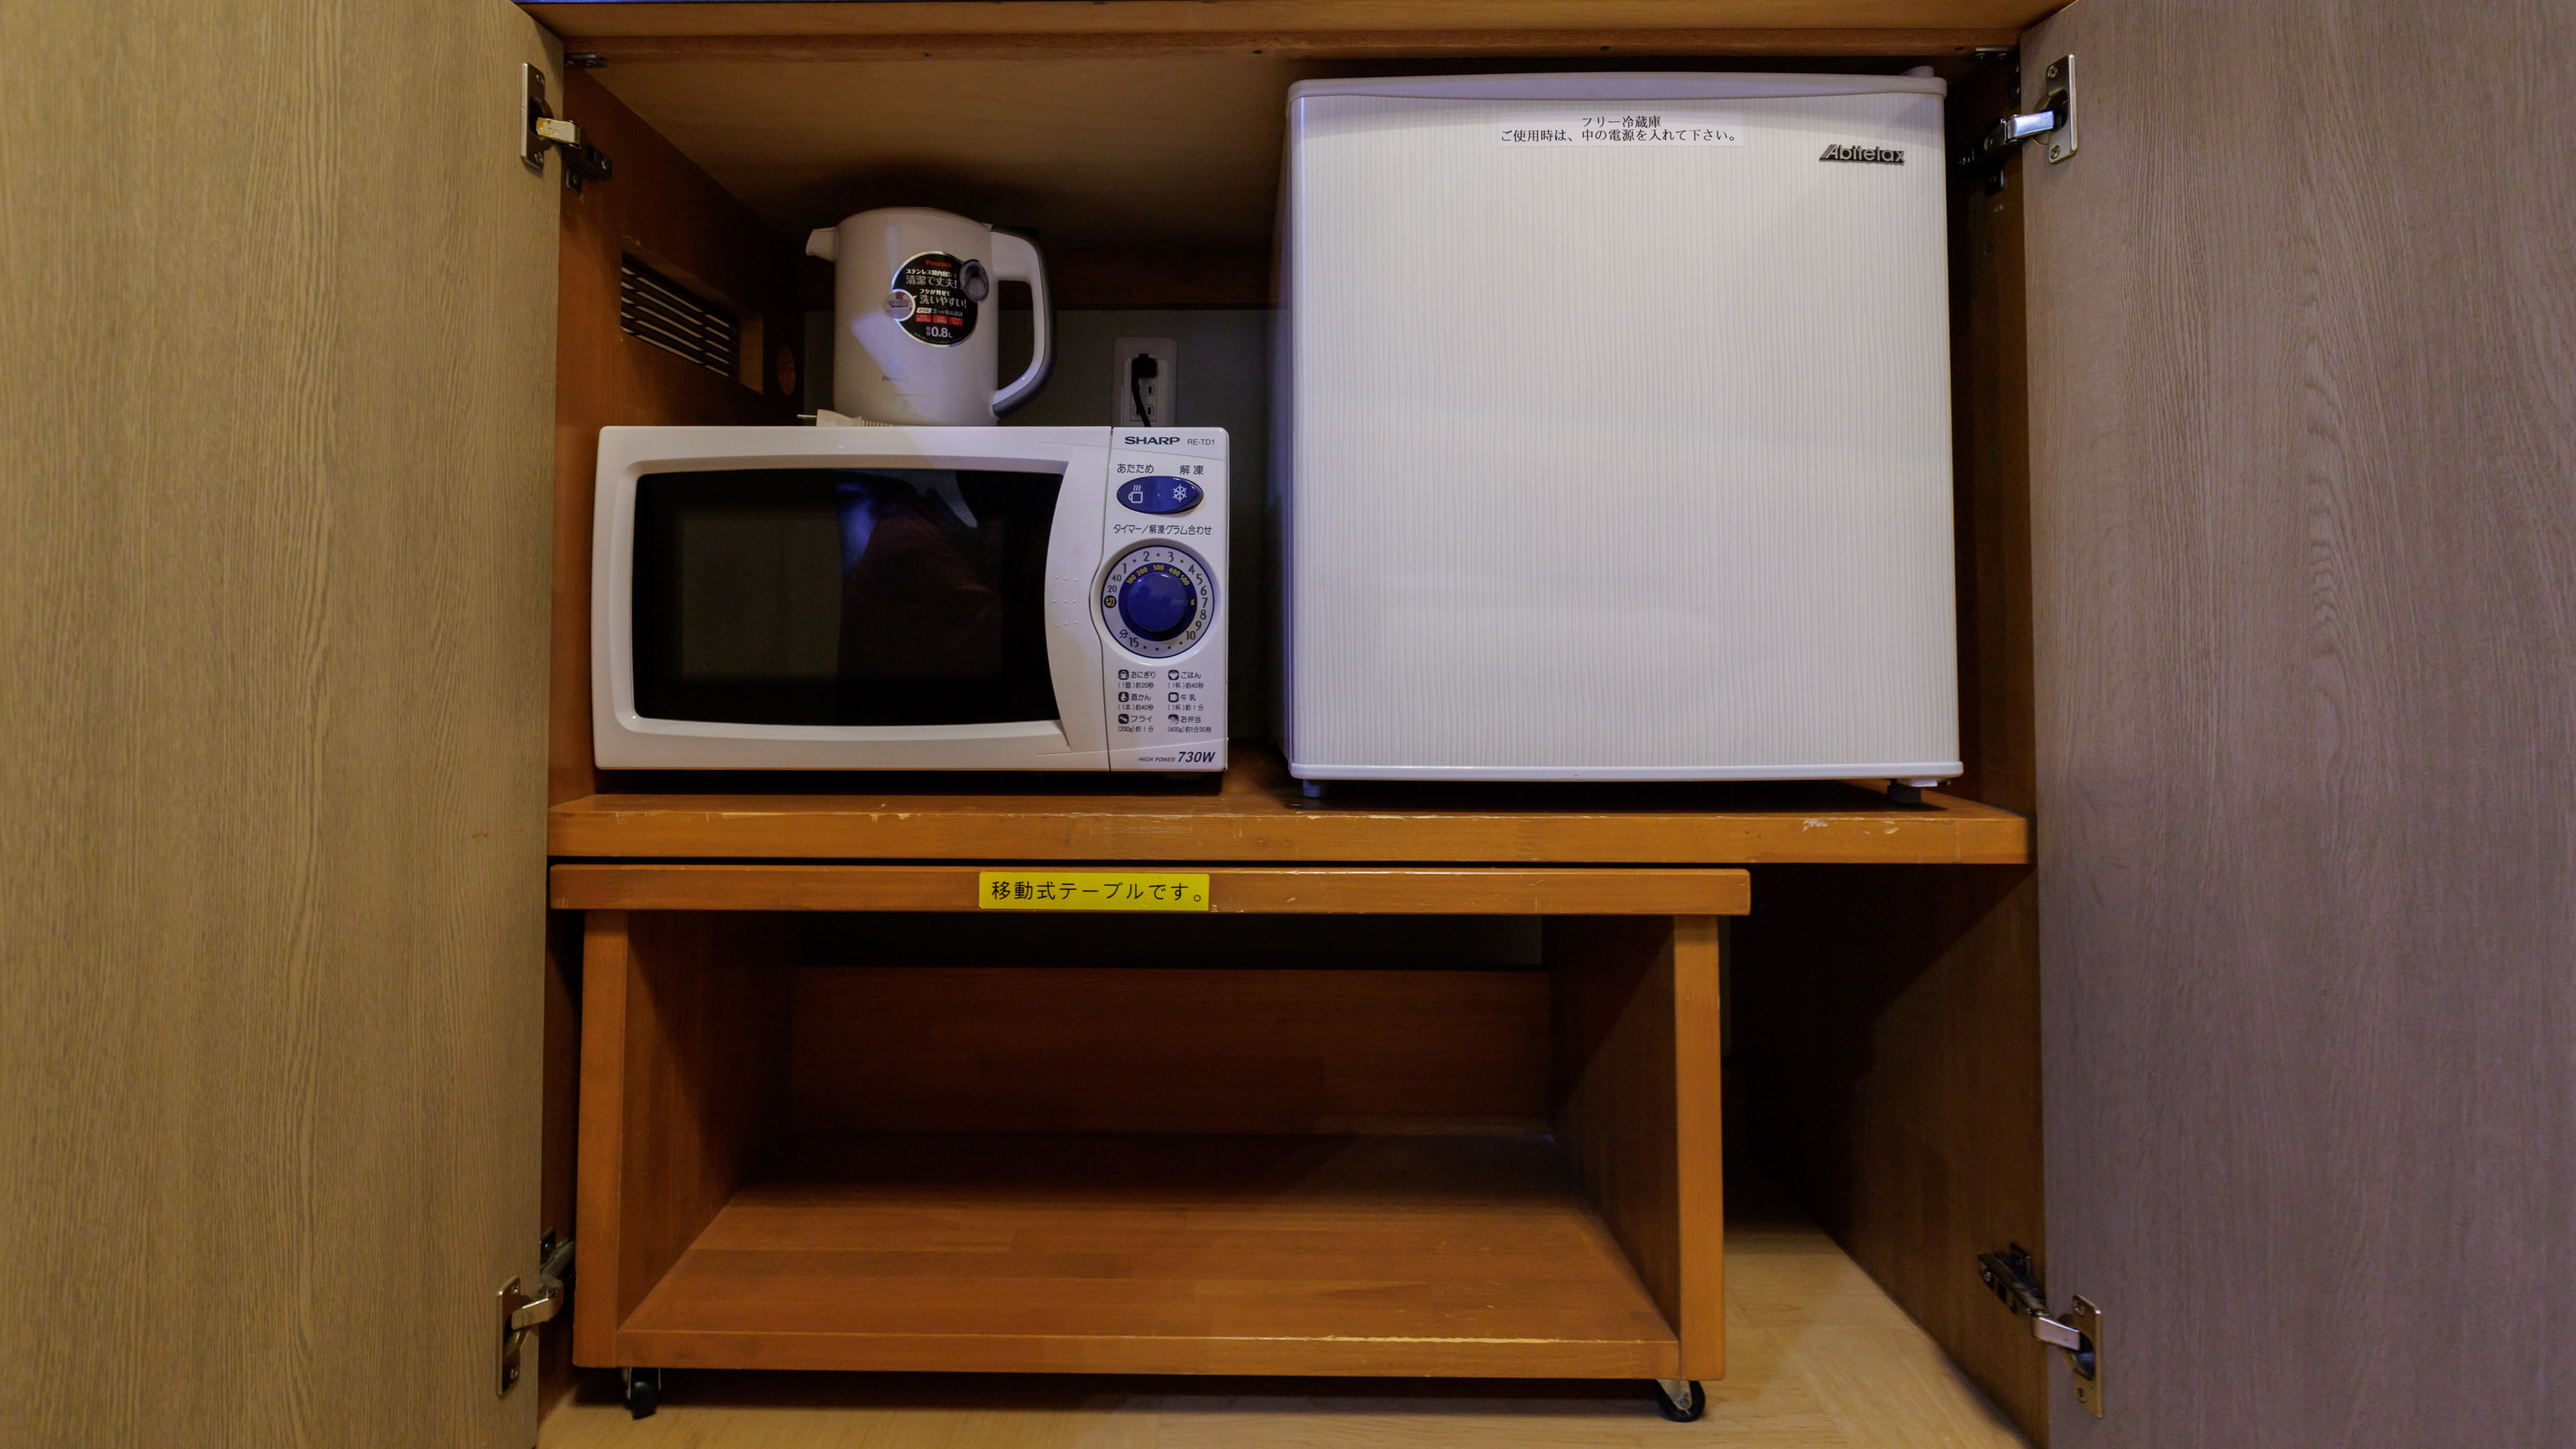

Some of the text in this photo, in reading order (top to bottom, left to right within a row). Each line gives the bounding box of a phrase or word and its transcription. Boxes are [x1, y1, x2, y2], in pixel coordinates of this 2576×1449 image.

[1581, 115, 1661, 128] フリー冷蔵庫
[1501, 129, 1737, 142] ご使用時は、中の電源を入れて下さい。
[1819, 143, 1906, 164] Abitelax
[1124, 436, 1180, 445] SHARP
[1117, 464, 1154, 474] あたため
[1143, 551, 1150, 562] 2
[1168, 552, 1174, 563] 3
[1122, 564, 1127, 574] 1
[1136, 567, 1148, 576] 200
[1188, 564, 1196, 575] 4
[1180, 575, 1190, 586] 500
[1196, 574, 1203, 586] 5
[1201, 586, 1207, 596] 6
[1202, 597, 1208, 608] 7
[1200, 609, 1207, 620] 8
[1196, 620, 1202, 631] 9
[1119, 629, 1129, 638] 分
[1186, 630, 1196, 641] 10
[1130, 637, 1140, 648] 15
[1180, 671, 1202, 680] ごはん
[1178, 752, 1216, 763] 730W
[992, 880, 1202, 902] 移動式テーブルです。
